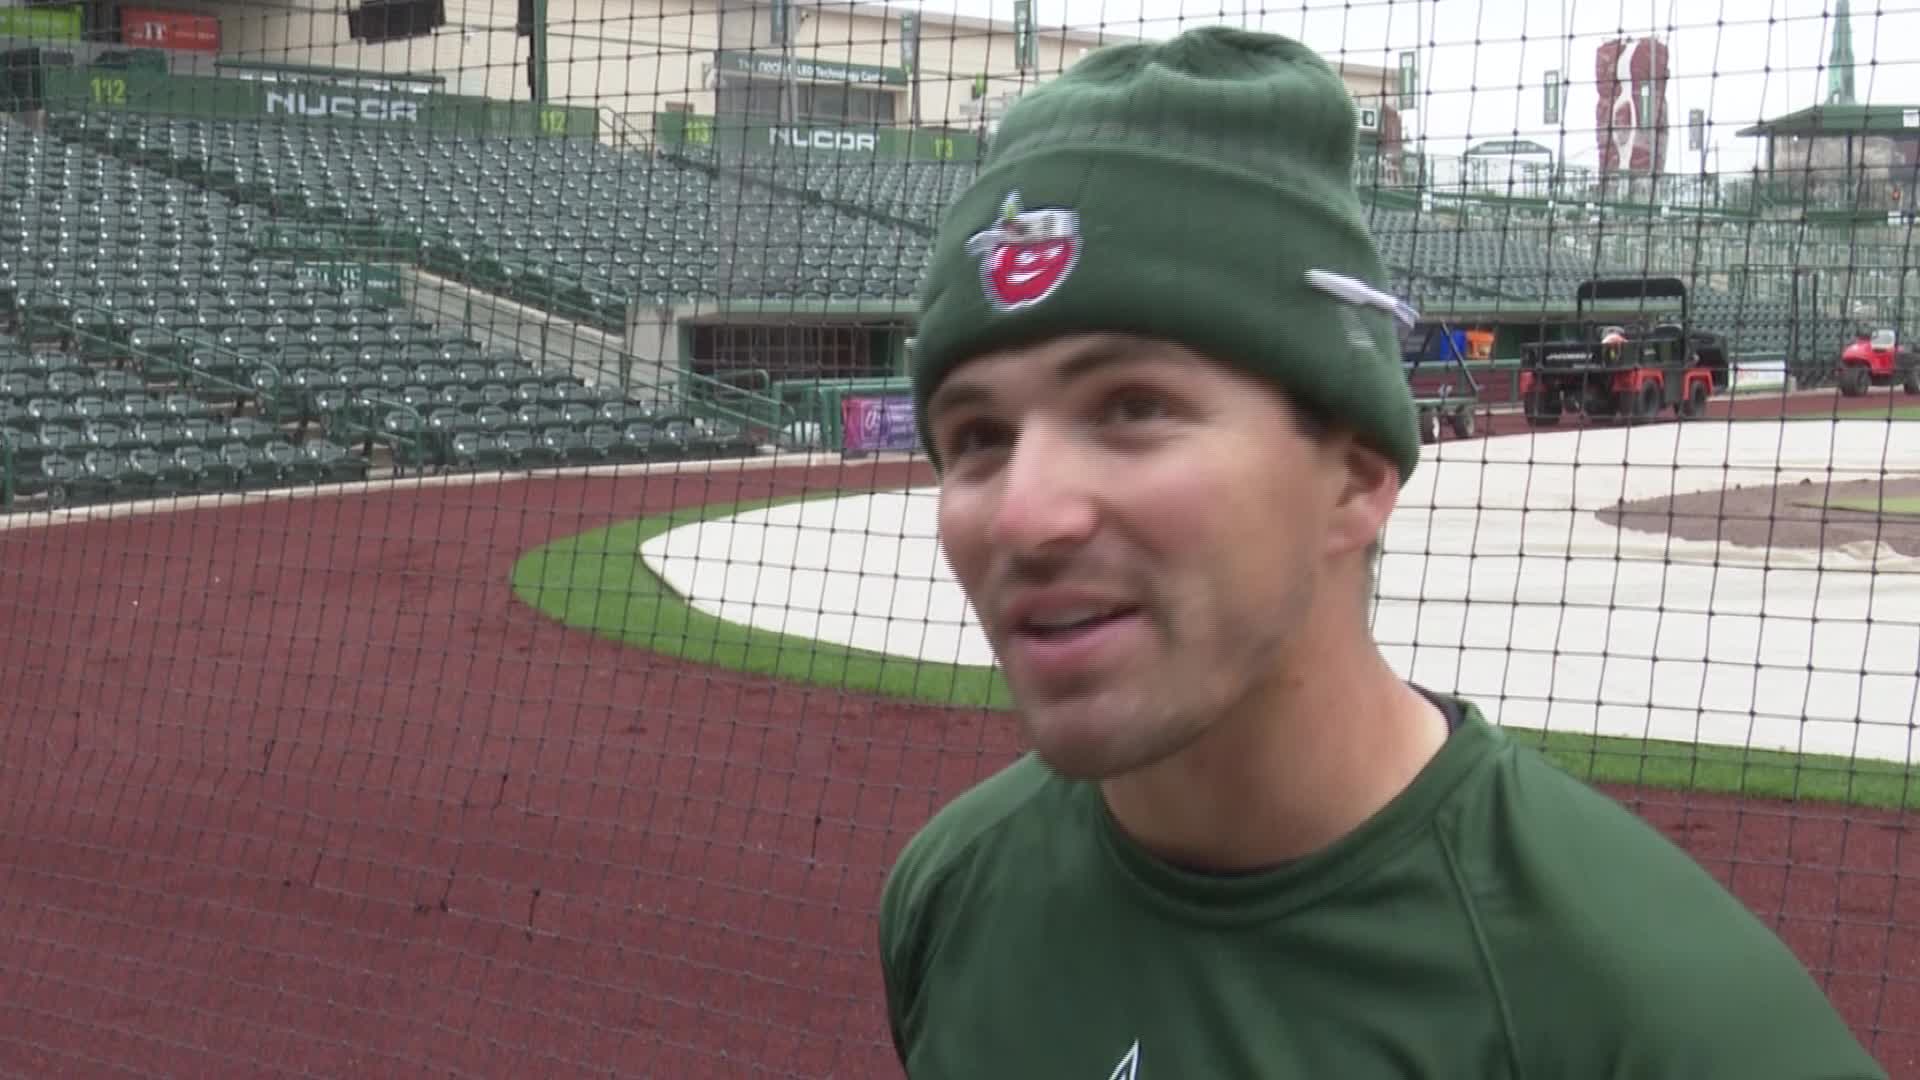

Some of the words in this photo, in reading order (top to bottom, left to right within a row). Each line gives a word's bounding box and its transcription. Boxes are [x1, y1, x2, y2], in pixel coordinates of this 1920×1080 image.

[815, 66, 859, 83] Technolgy
[861, 71, 887, 82] Centr
[90, 78, 125, 104] 112
[267, 91, 417, 122] NUCOR
[540, 110, 566, 134] 112
[769, 127, 876, 151] NUCOR
